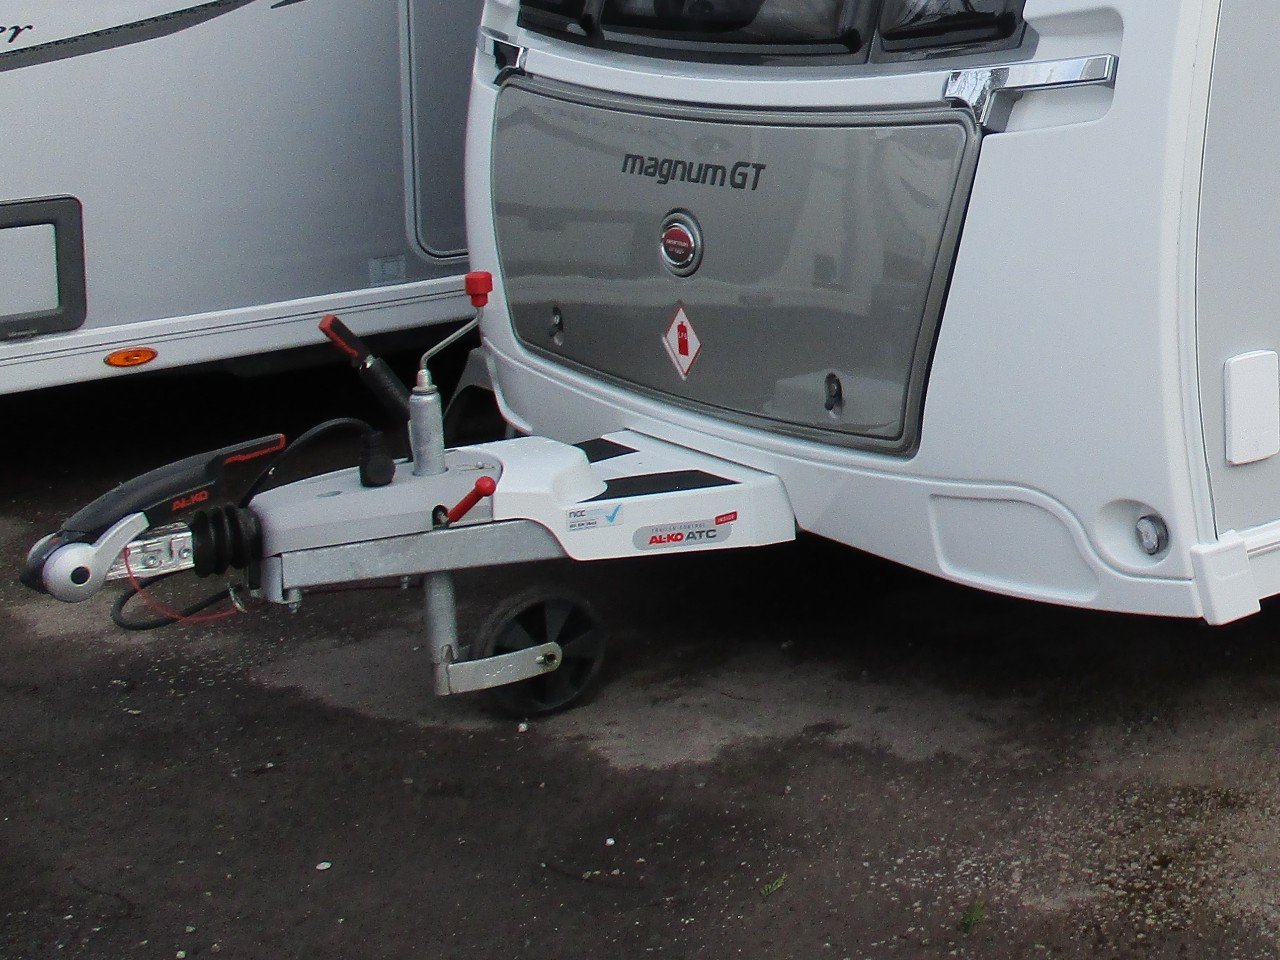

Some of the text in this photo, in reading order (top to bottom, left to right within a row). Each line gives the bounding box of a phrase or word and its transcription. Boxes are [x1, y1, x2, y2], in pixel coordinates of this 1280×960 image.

[621, 153, 767, 190] magnum GT
[648, 529, 717, 545] AL-KO ATC
